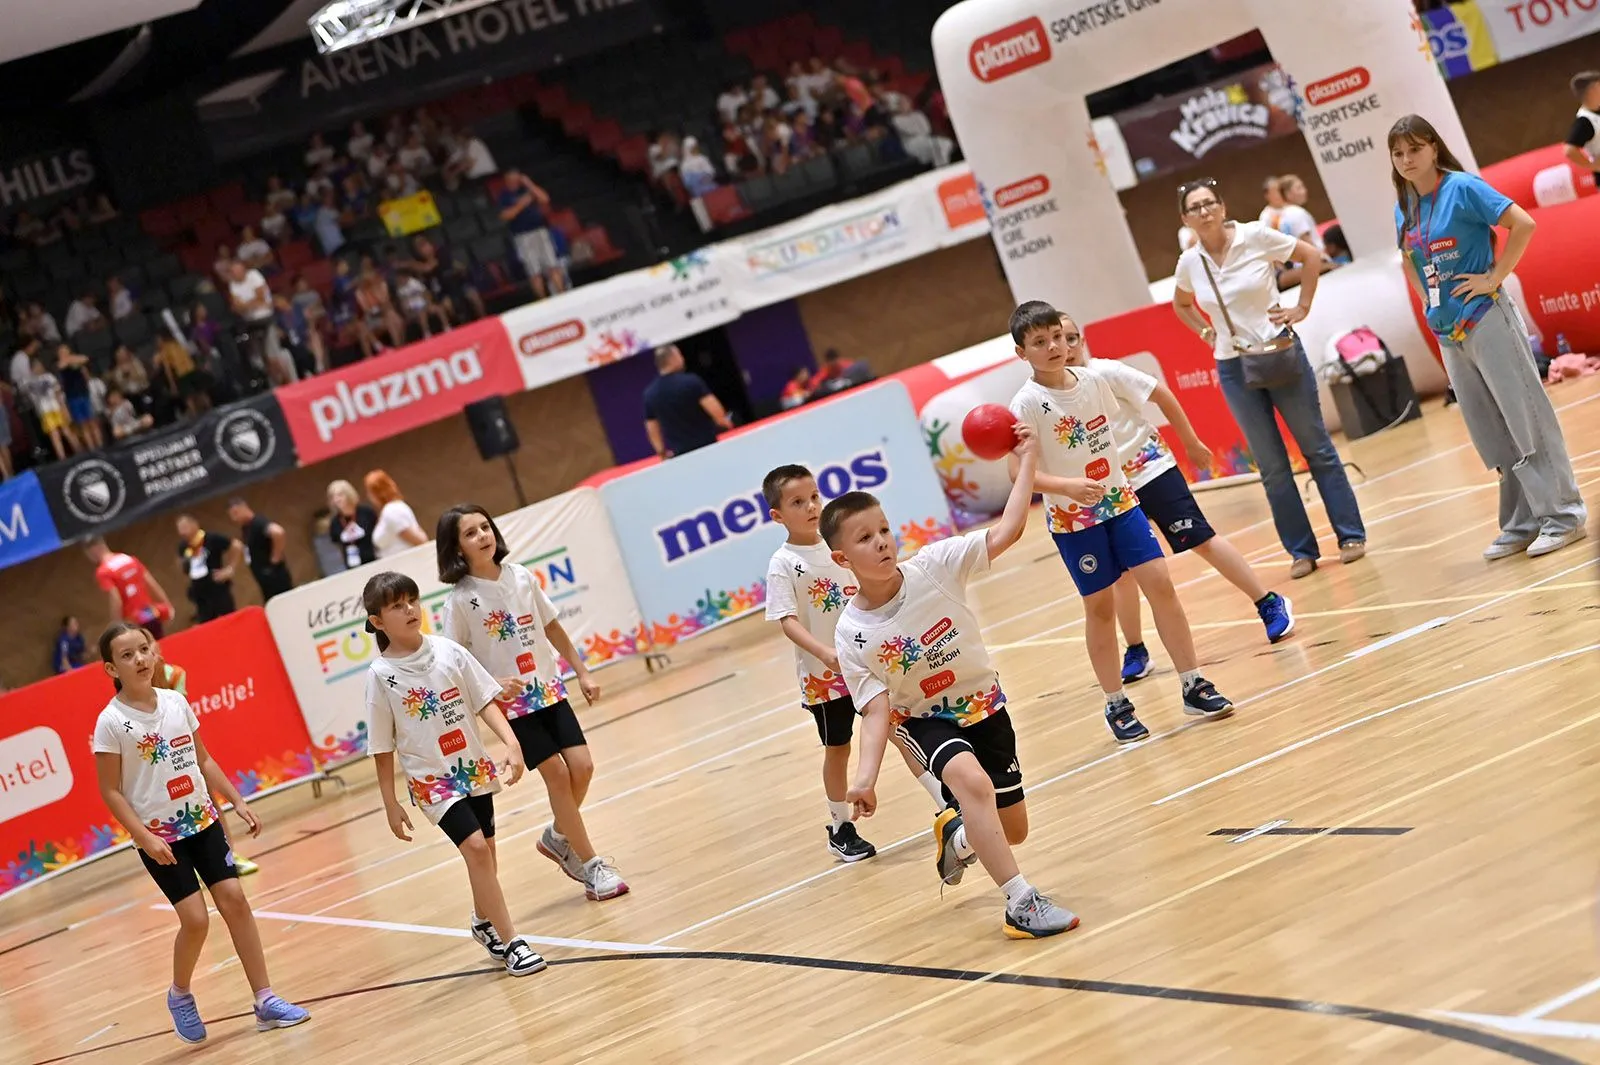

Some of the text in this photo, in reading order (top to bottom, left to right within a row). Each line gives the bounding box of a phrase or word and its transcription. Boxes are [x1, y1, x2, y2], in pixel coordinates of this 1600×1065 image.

[300, 0, 570, 99] ARENA HOTEL
[310, 347, 484, 443] plazma
[657, 450, 888, 563] meos
[923, 620, 949, 645] plazma
[923, 627, 960, 658] SPORTSKE
[926, 651, 946, 663] IGRE
[928, 648, 962, 671] MLADIH
[441, 734, 464, 750] m:tel
[174, 759, 196, 772] MLADIH
[170, 779, 192, 794] m:tel
